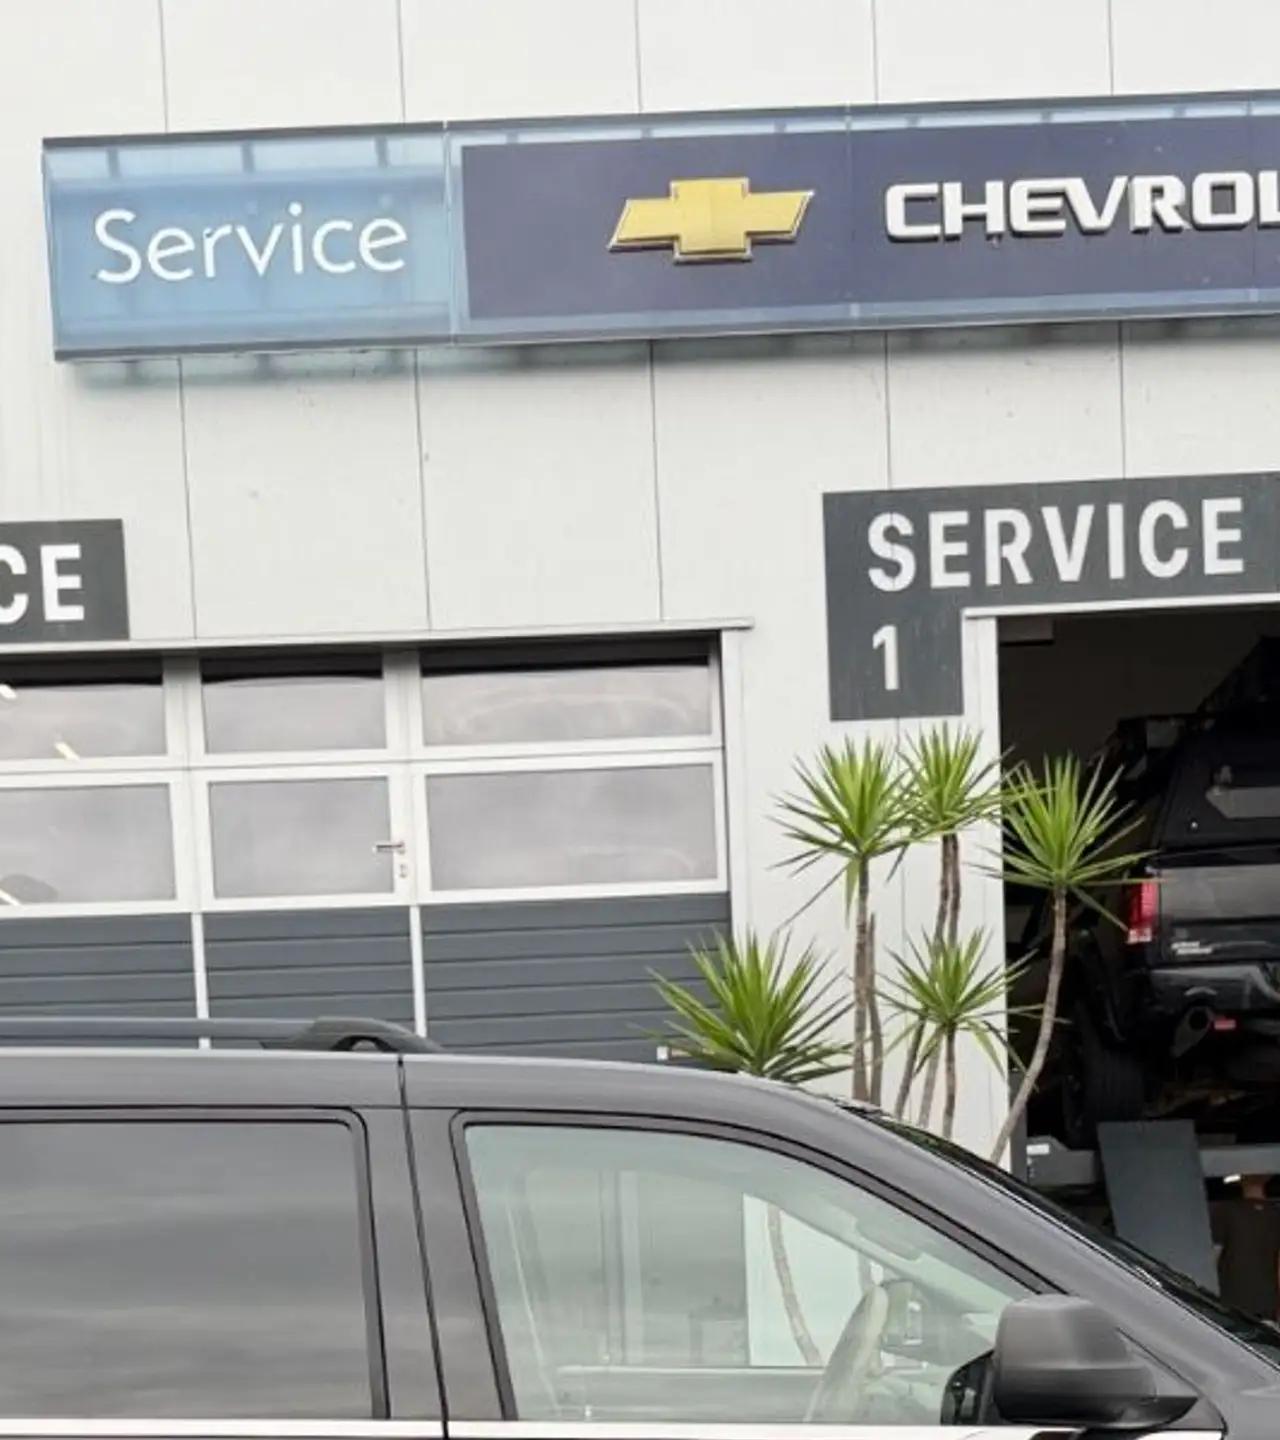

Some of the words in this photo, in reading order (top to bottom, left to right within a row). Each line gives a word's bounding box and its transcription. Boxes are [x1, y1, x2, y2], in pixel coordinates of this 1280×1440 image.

[94, 201, 408, 283] Service
[867, 497, 1245, 592] SERVICE
[872, 624, 900, 691] 1
